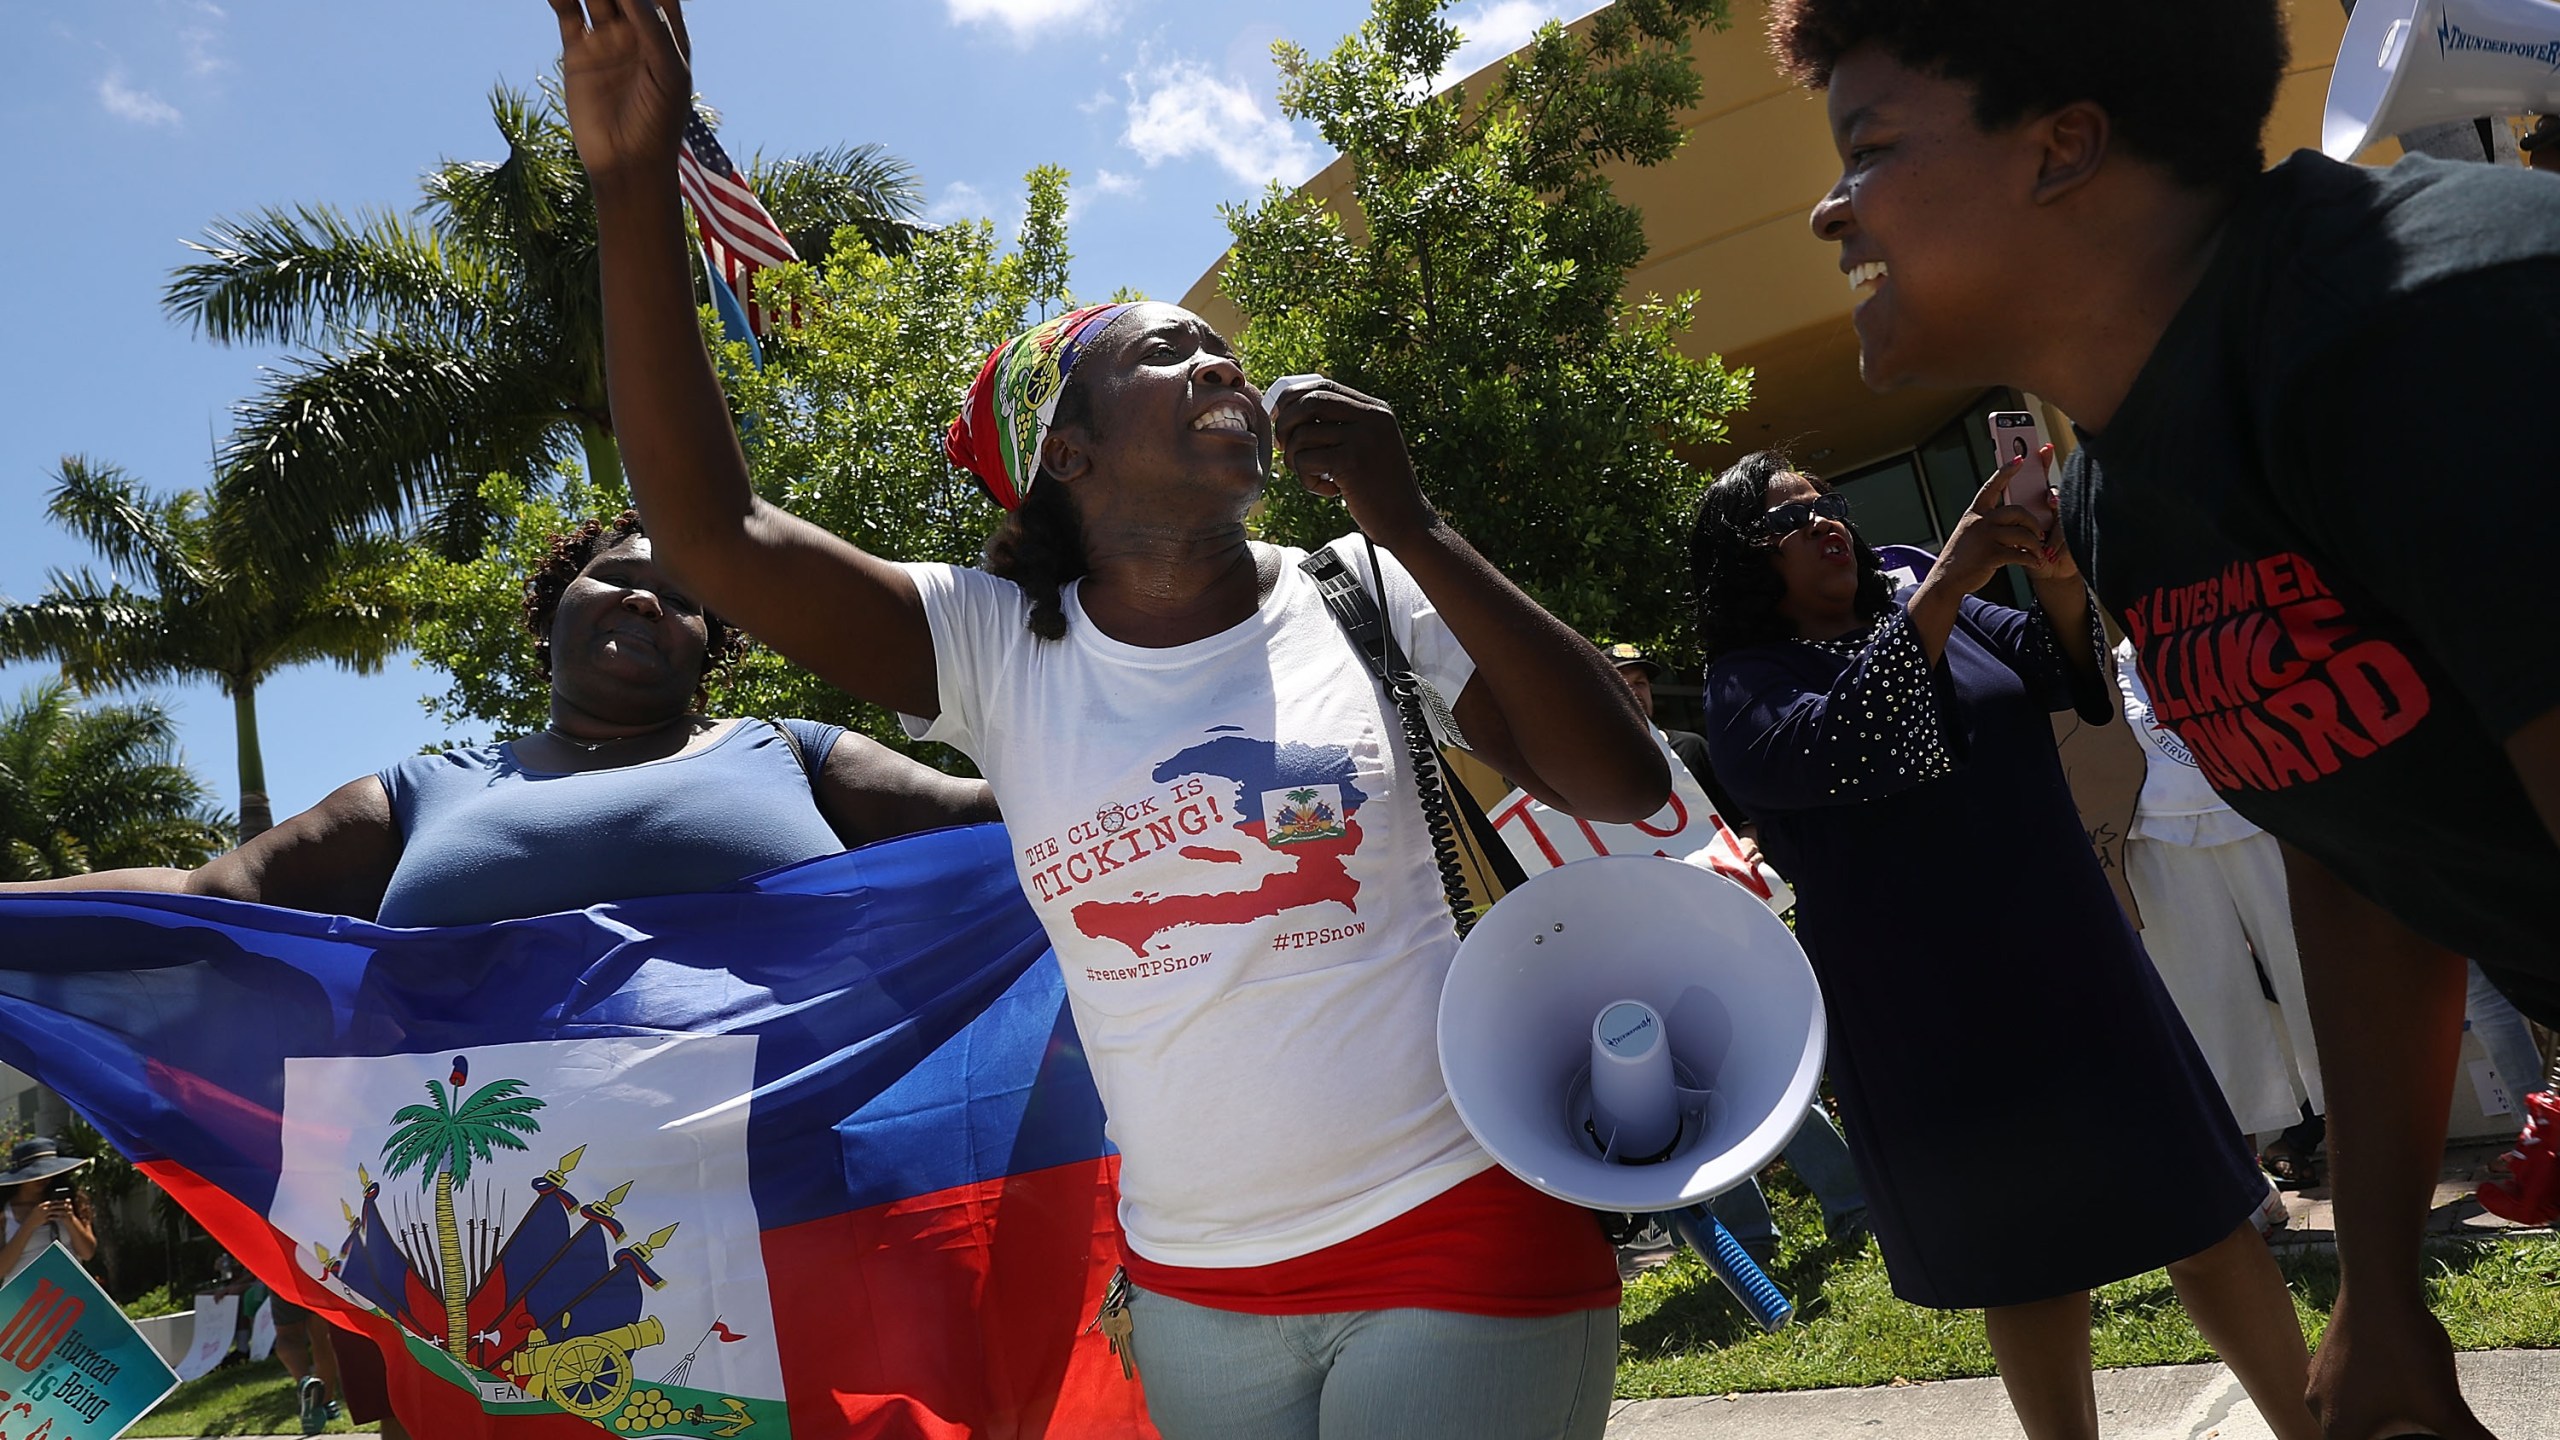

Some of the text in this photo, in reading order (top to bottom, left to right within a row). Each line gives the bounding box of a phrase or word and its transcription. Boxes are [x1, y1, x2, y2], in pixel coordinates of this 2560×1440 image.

[2153, 576, 2220, 636] LIVES
[2222, 552, 2333, 619] MAER
[1025, 778, 1205, 867] THE CLOCK IS
[1032, 795, 1225, 903] TICKING!
[1086, 950, 1214, 982] #renewTPSnow
[1272, 920, 1366, 951] #TPSnow
[0, 1277, 121, 1386] NO Human
[52, 1371, 111, 1424] Being
